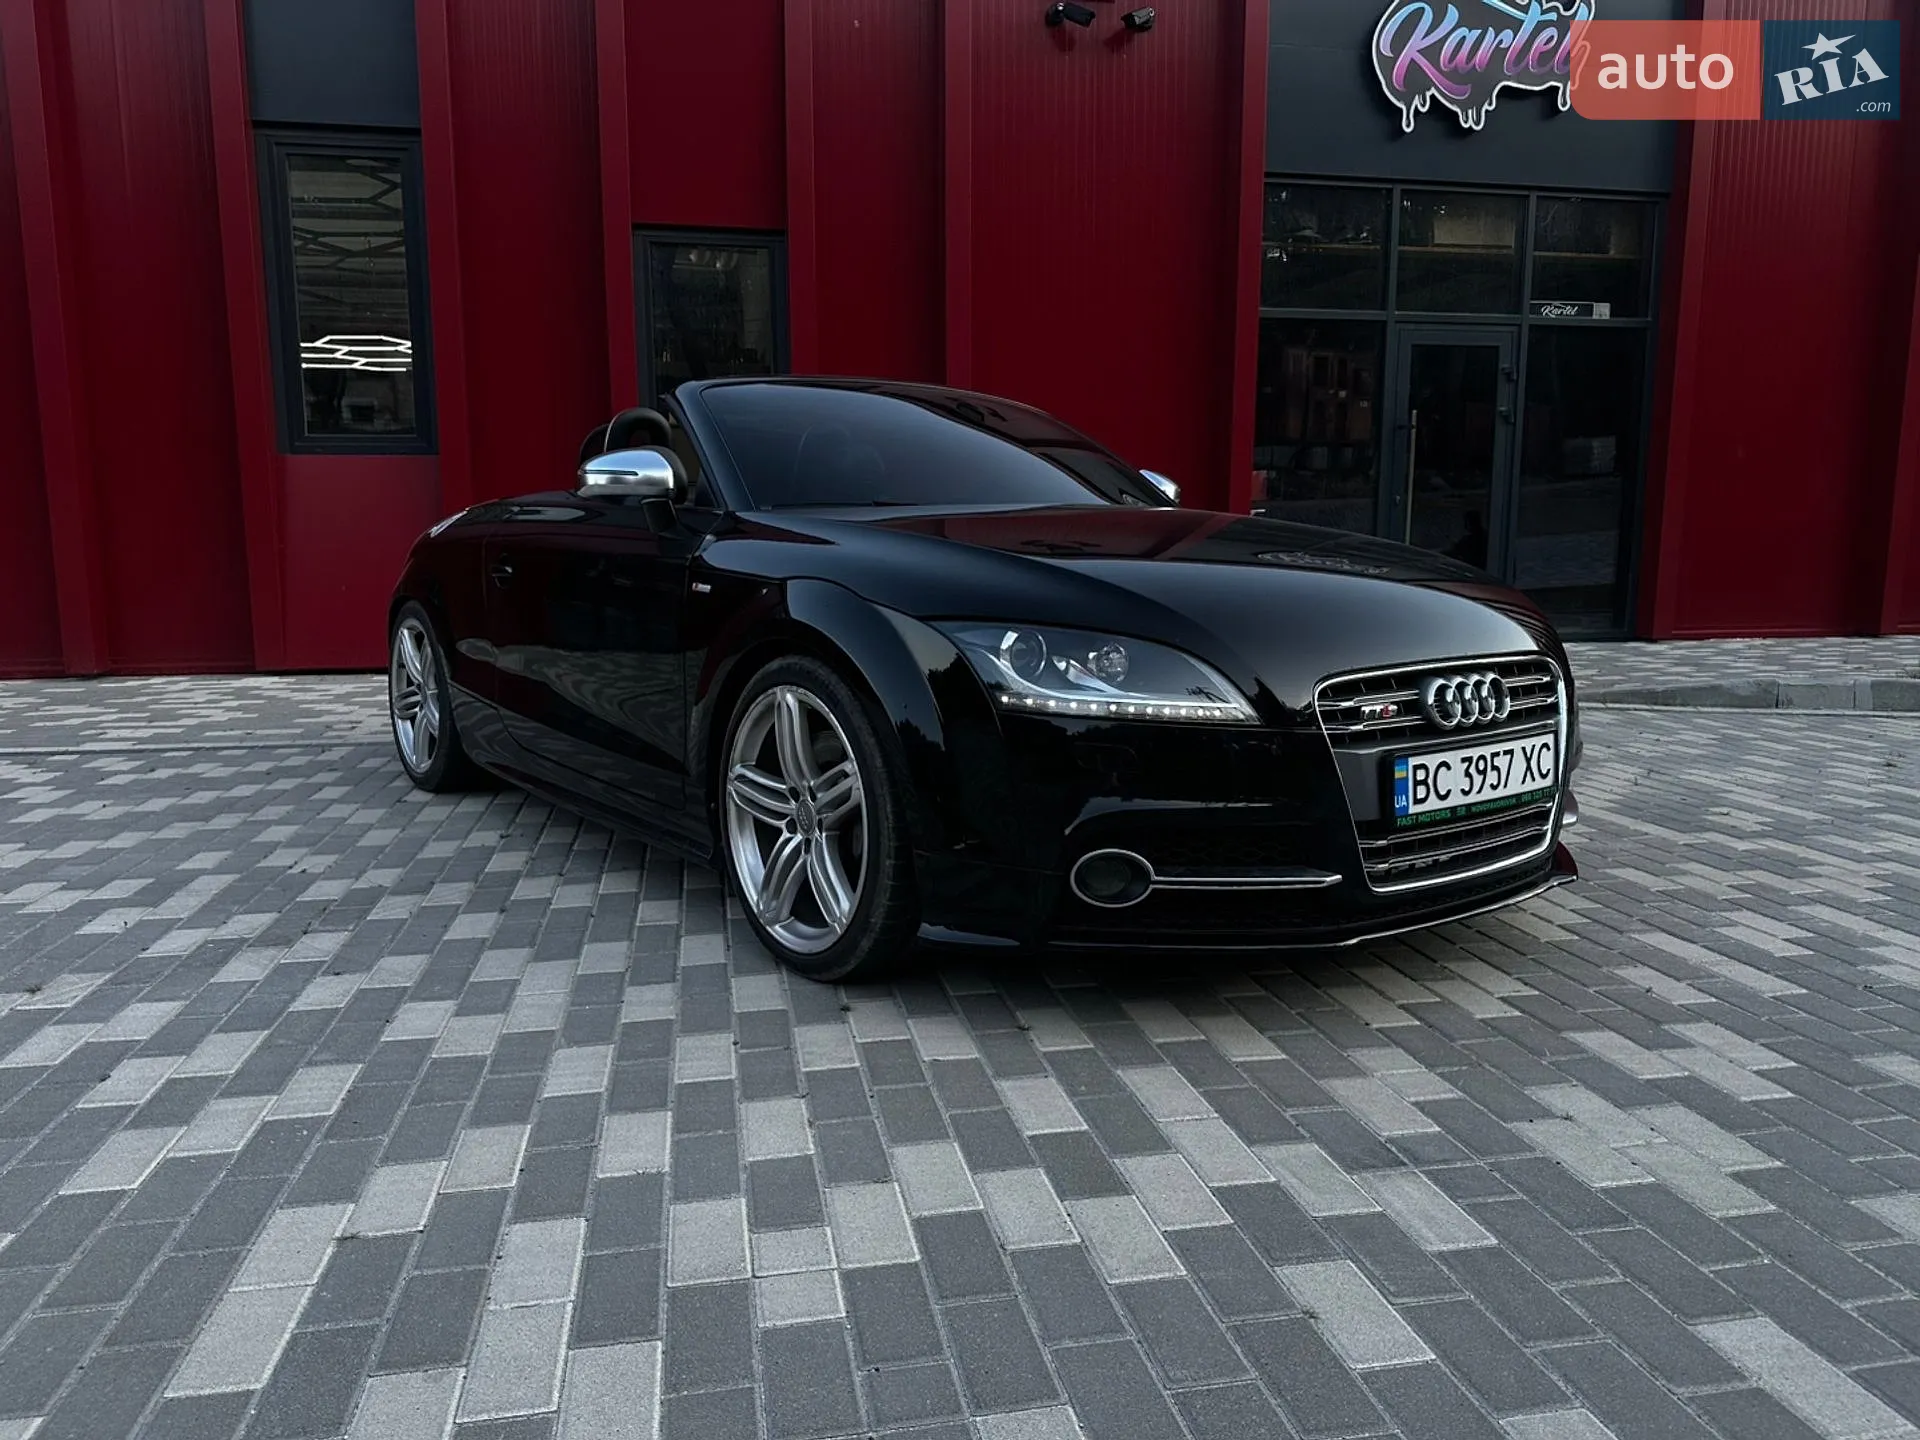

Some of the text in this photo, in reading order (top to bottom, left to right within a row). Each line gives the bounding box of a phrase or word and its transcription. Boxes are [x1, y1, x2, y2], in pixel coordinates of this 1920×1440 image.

[1412, 742, 1551, 805] BC 3957 XC
[1394, 794, 1407, 808] UA
[1397, 809, 1451, 827] FAST MOTORS
